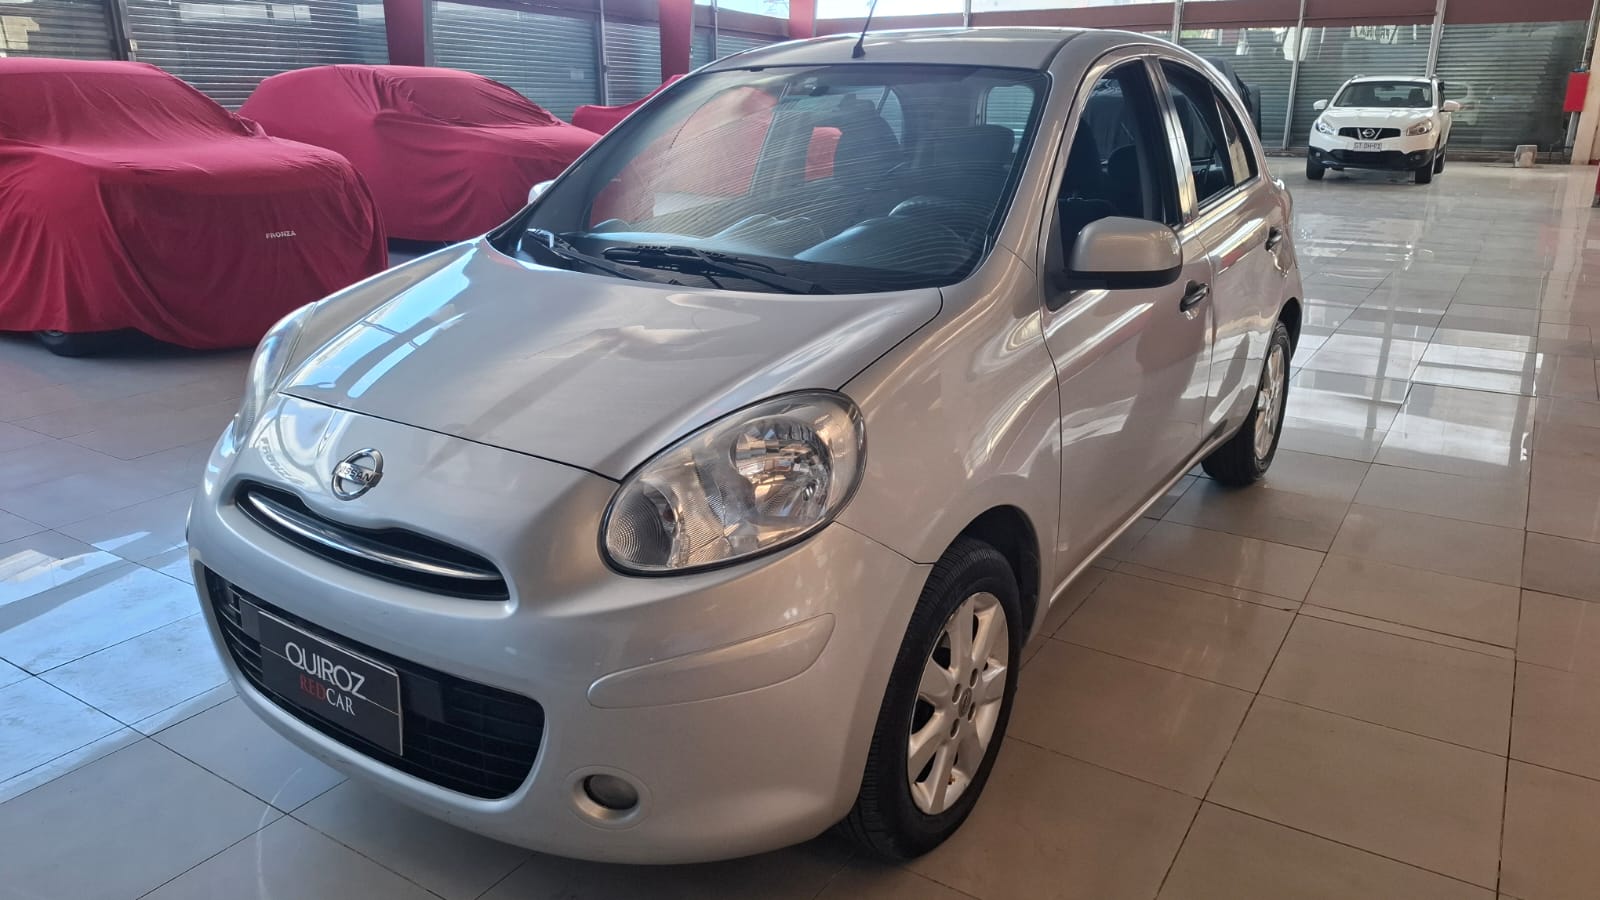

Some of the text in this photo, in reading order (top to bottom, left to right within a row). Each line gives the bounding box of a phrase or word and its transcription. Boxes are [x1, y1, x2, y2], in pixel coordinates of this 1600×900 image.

[265, 230, 297, 239] FRONZA
[339, 464, 376, 484] NISSAN
[285, 641, 366, 701] QUIROZ
